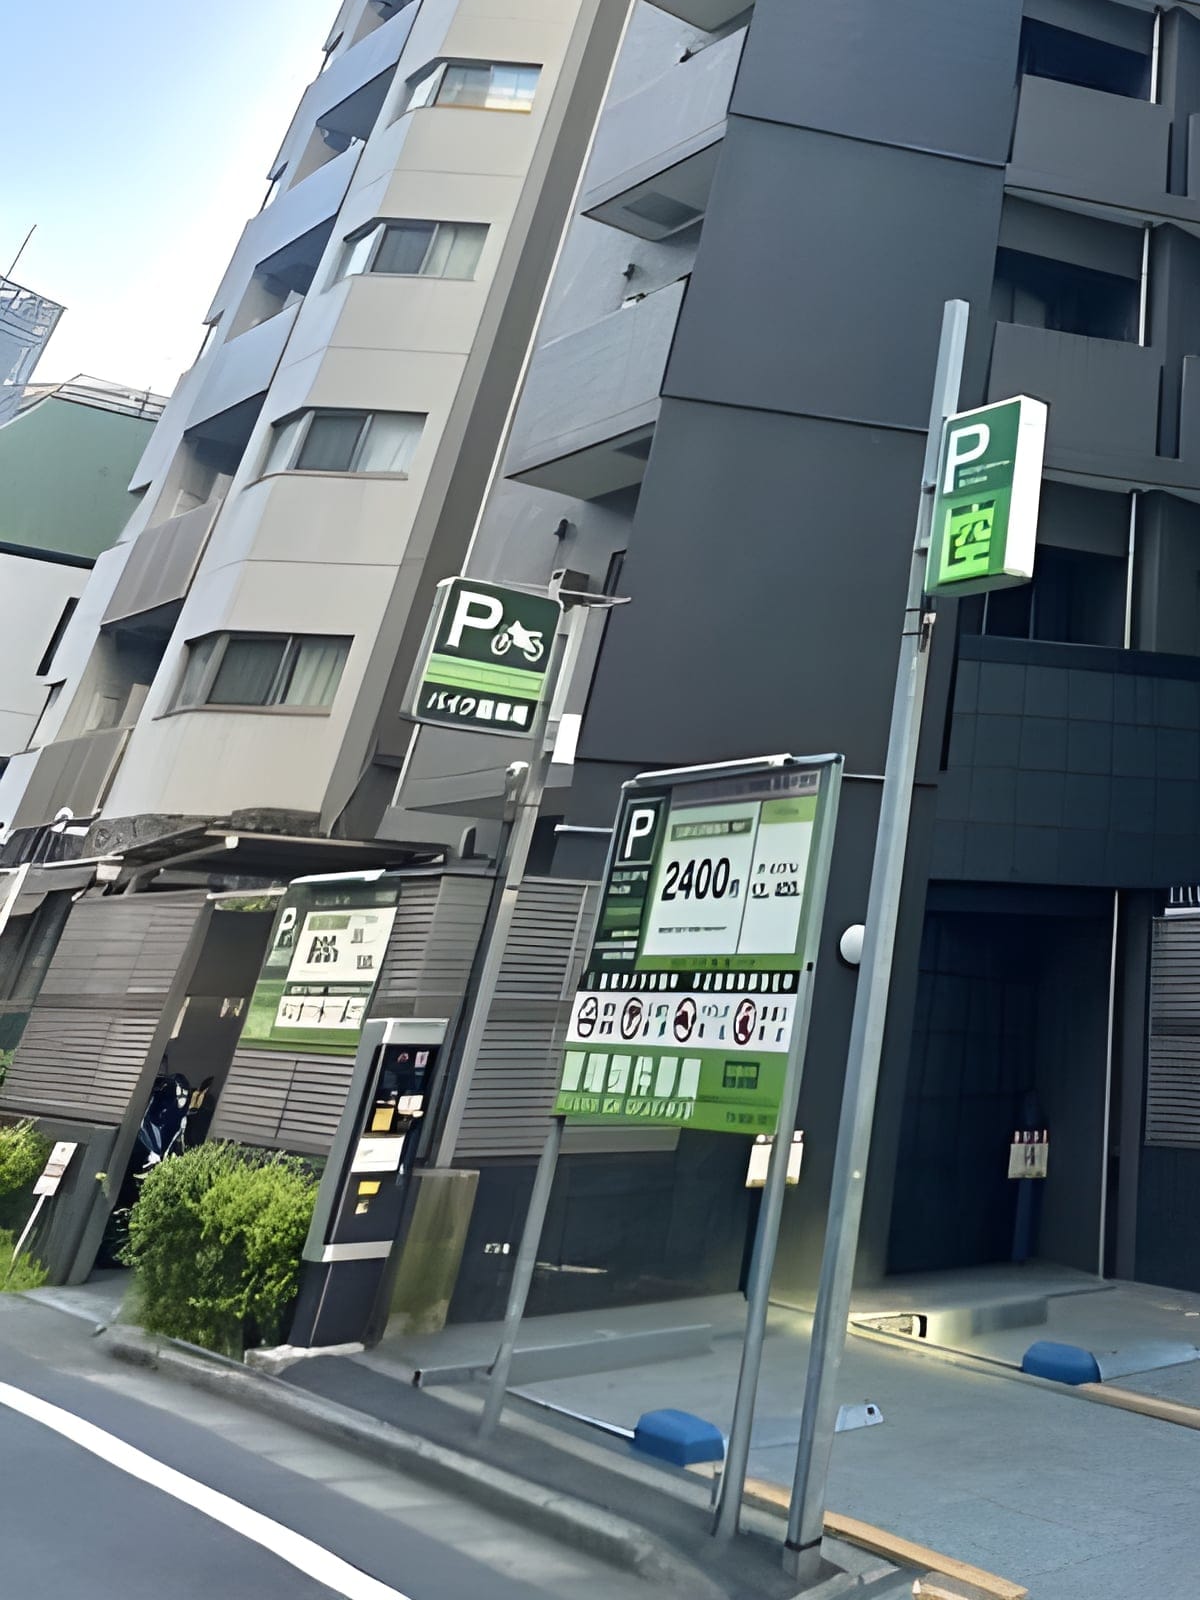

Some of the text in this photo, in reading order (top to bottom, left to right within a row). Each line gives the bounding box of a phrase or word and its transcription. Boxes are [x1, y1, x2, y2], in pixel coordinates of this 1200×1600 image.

[943, 423, 990, 495] P
[446, 590, 503, 648] P
[624, 809, 656, 859] P
